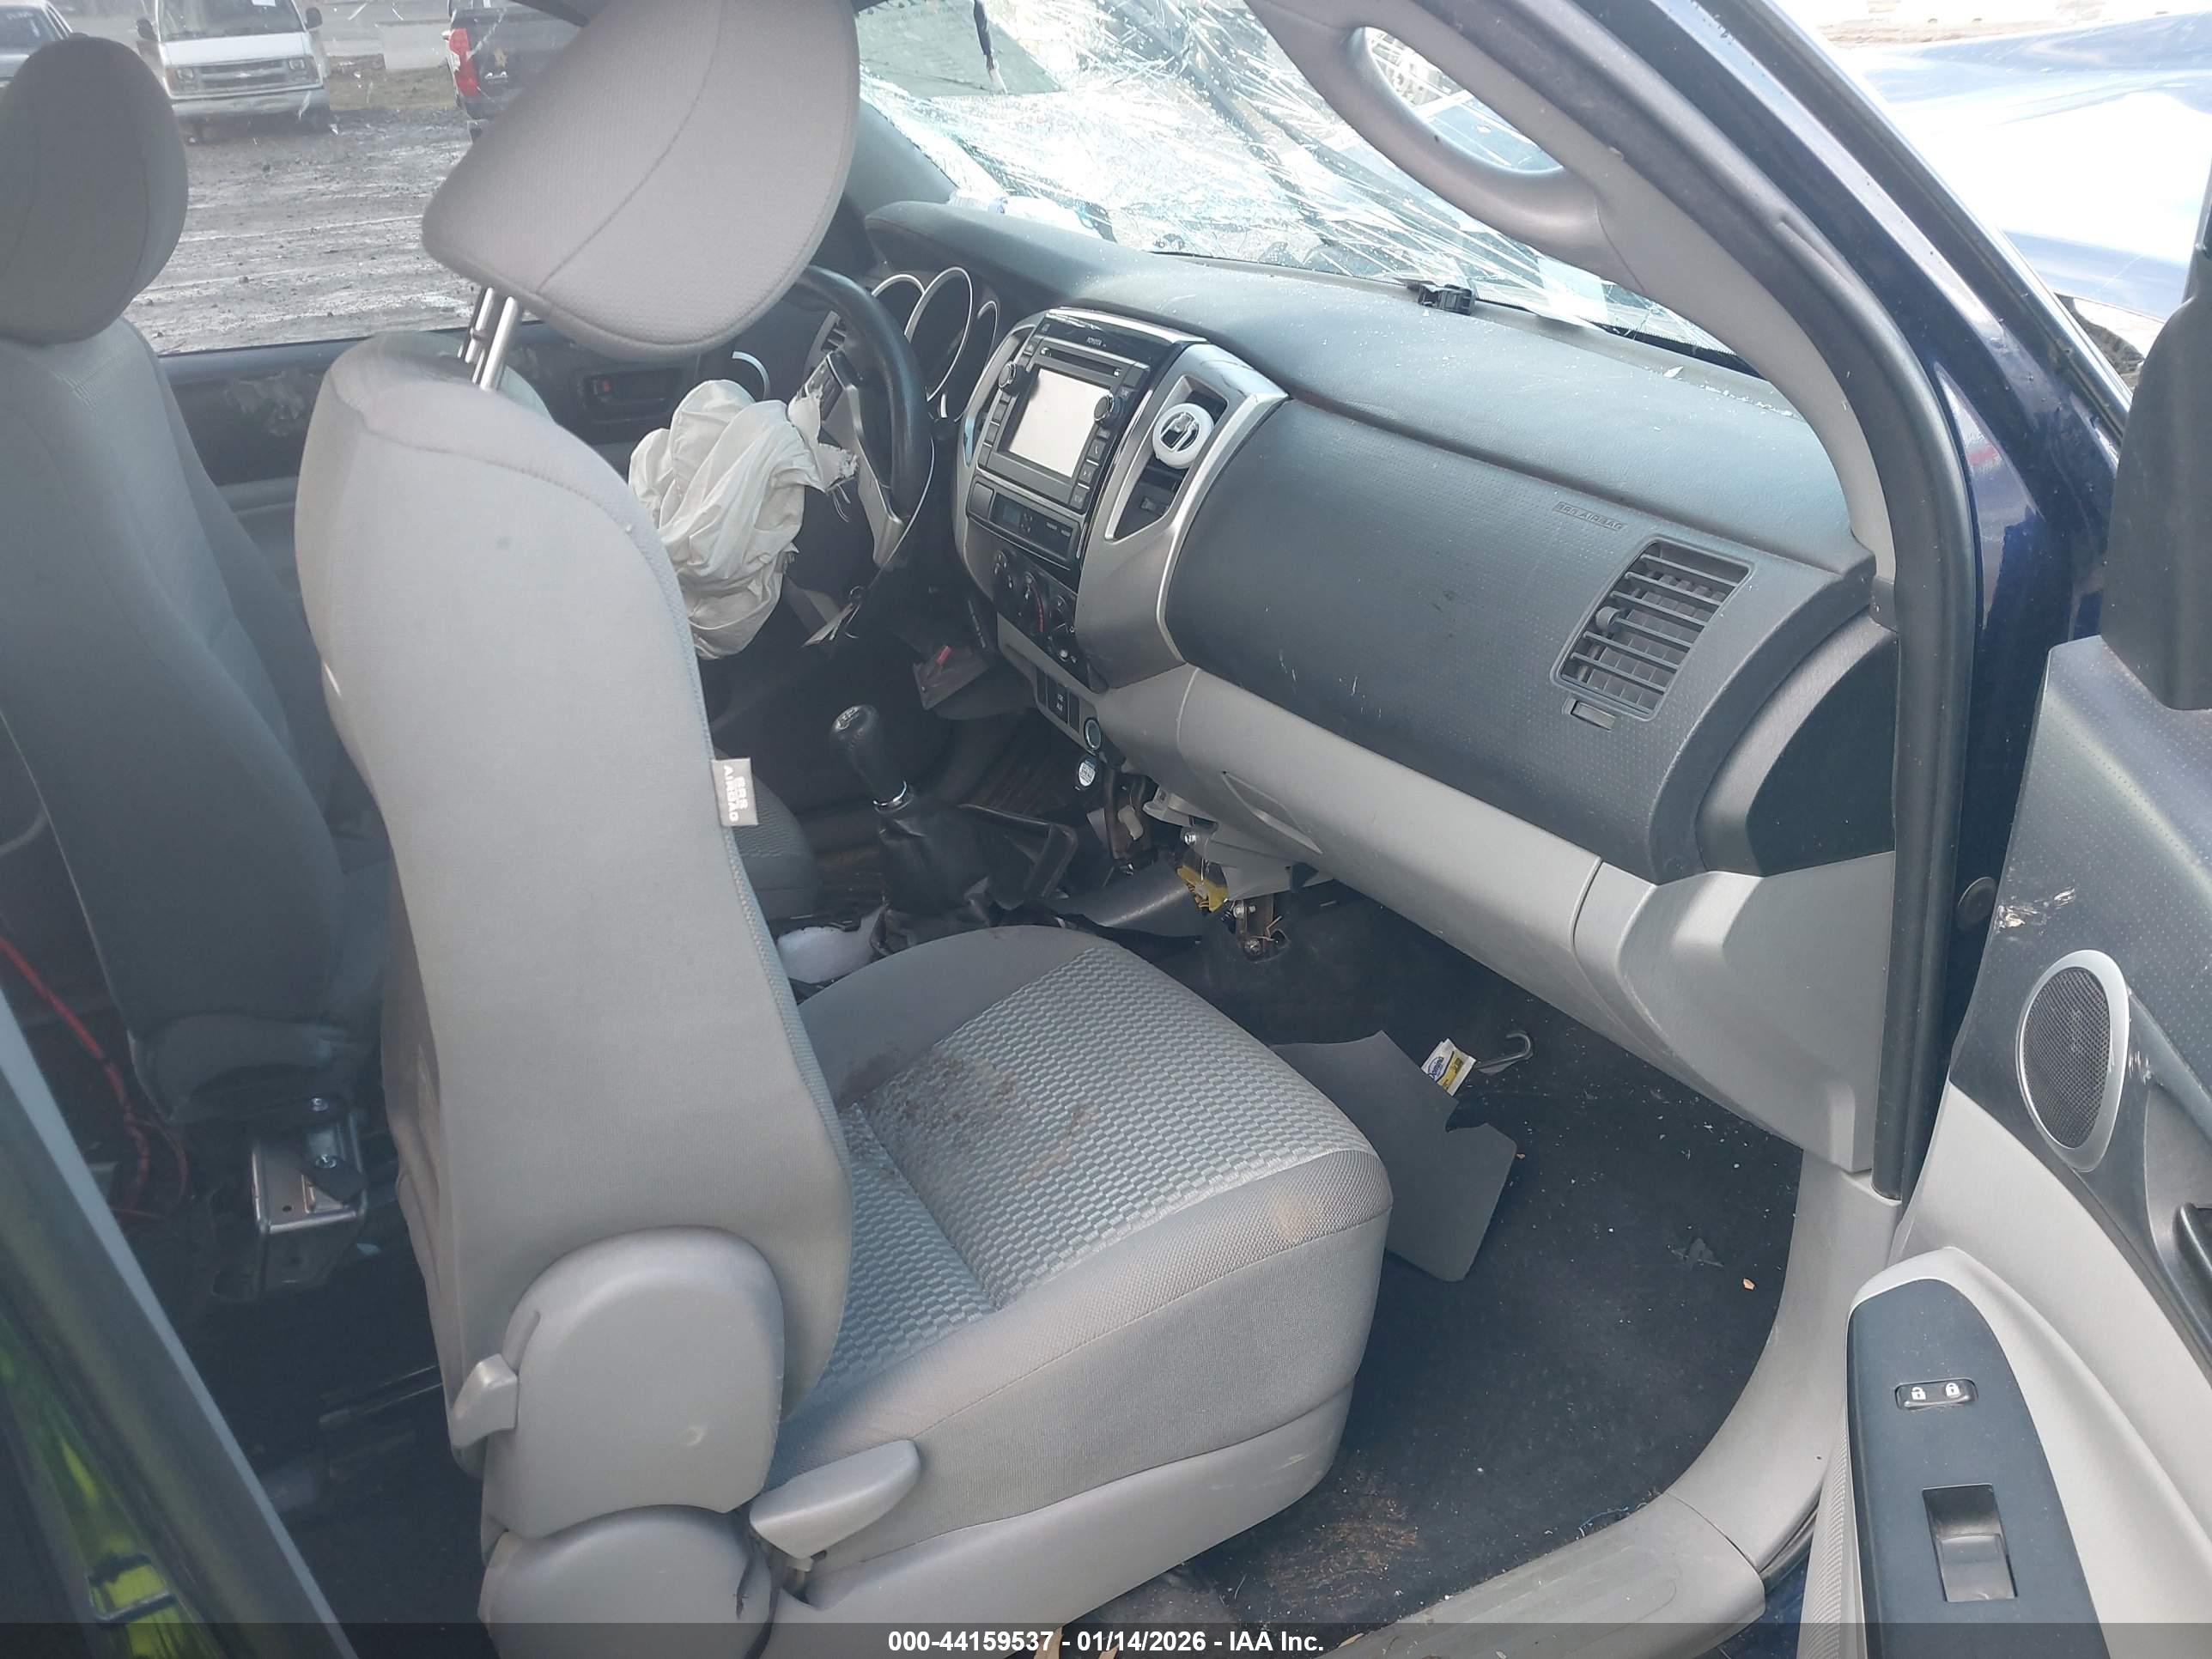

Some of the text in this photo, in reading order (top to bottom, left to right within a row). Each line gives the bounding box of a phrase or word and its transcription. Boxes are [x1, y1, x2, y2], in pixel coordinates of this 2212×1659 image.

[1555, 503, 1623, 530] SRS AIRBAG
[724, 765, 738, 822] AIRBAG
